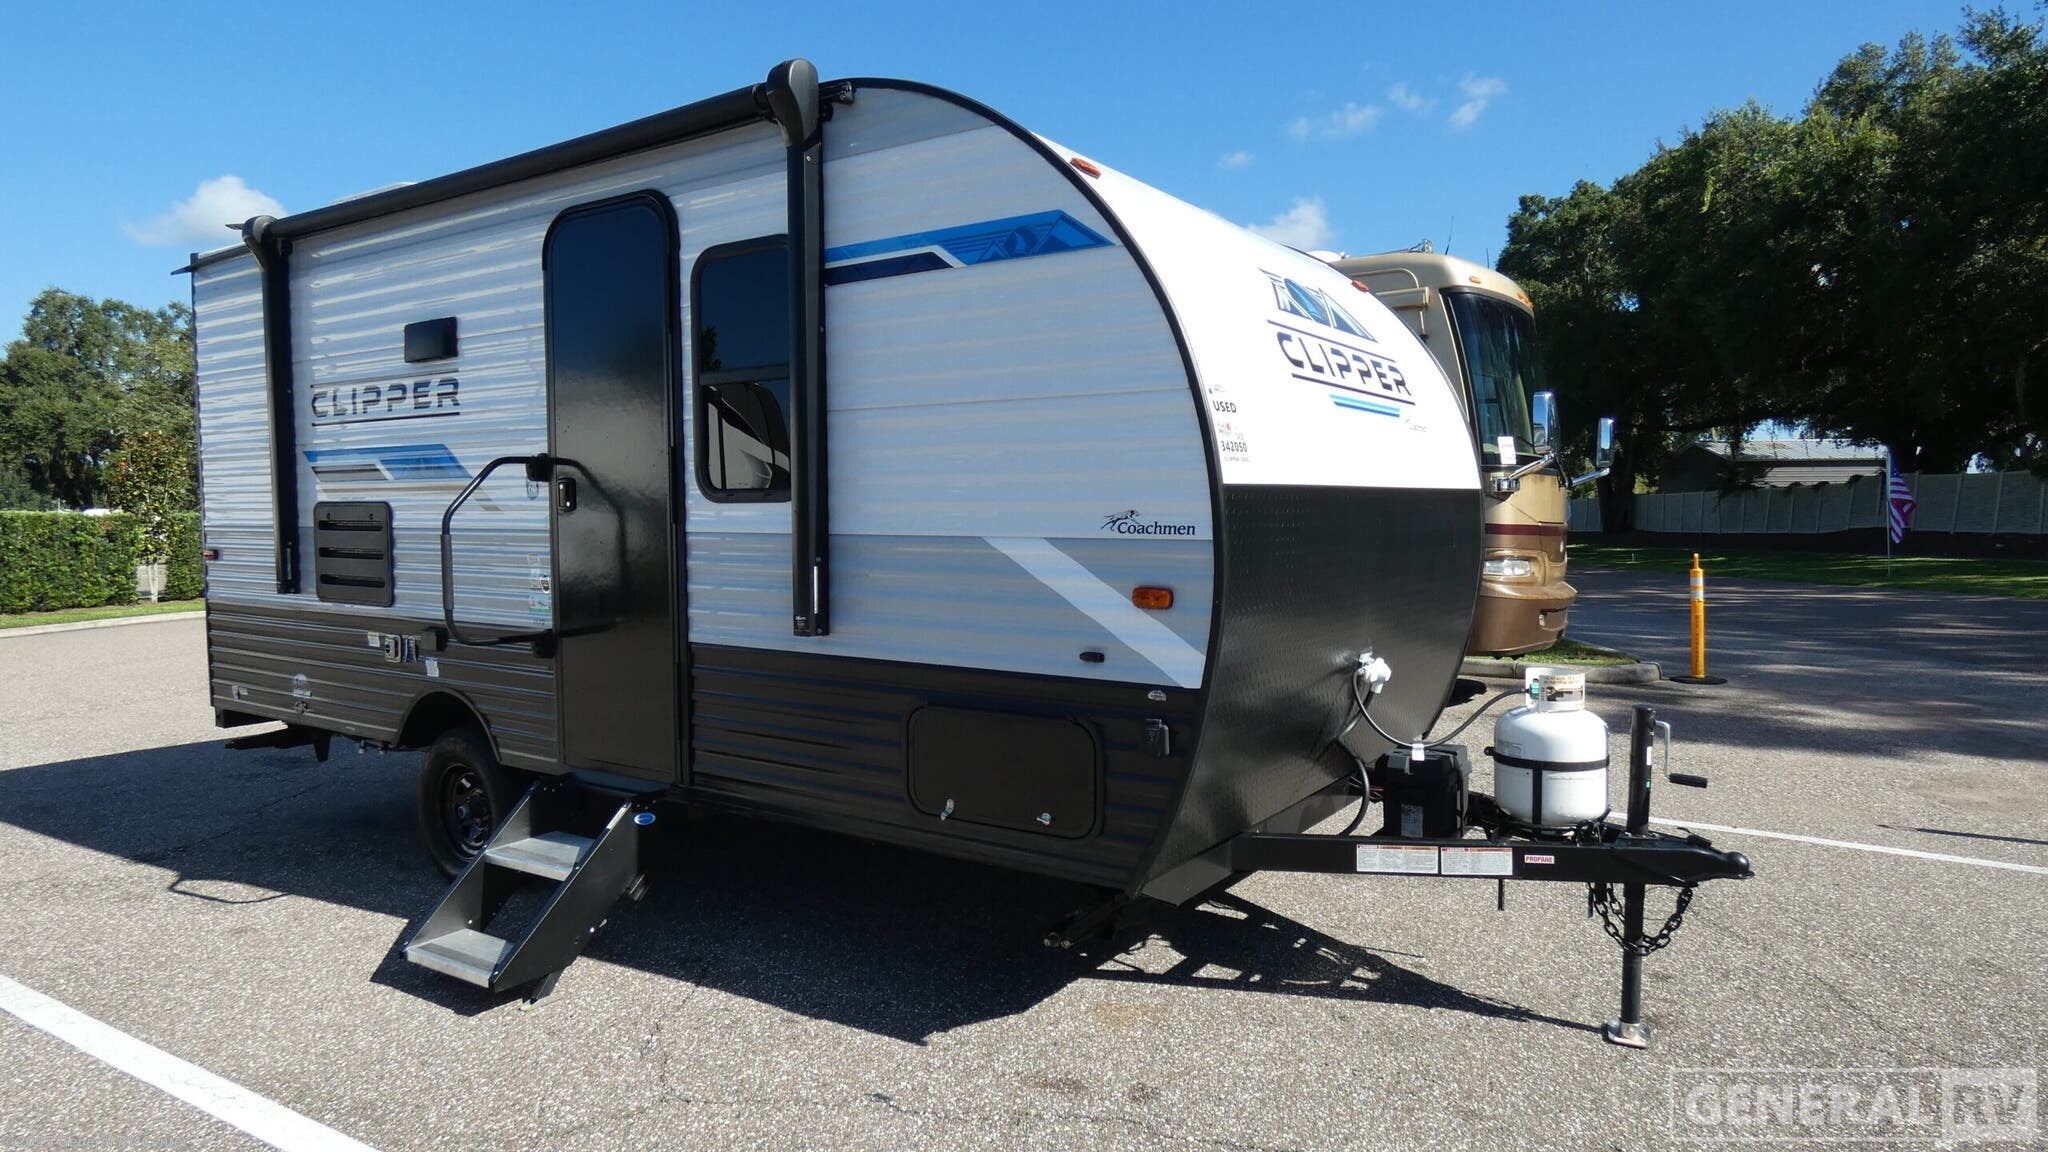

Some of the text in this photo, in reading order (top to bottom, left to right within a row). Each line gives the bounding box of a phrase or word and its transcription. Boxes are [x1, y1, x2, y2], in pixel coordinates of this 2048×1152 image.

[1276, 331, 1412, 397] CLIPPER
[311, 376, 461, 418] CLIPPER
[1212, 400, 1237, 413] USED
[1220, 440, 1248, 453] 342050
[1117, 521, 1196, 536] Coachmen
[1525, 855, 1553, 863] PROPANE
